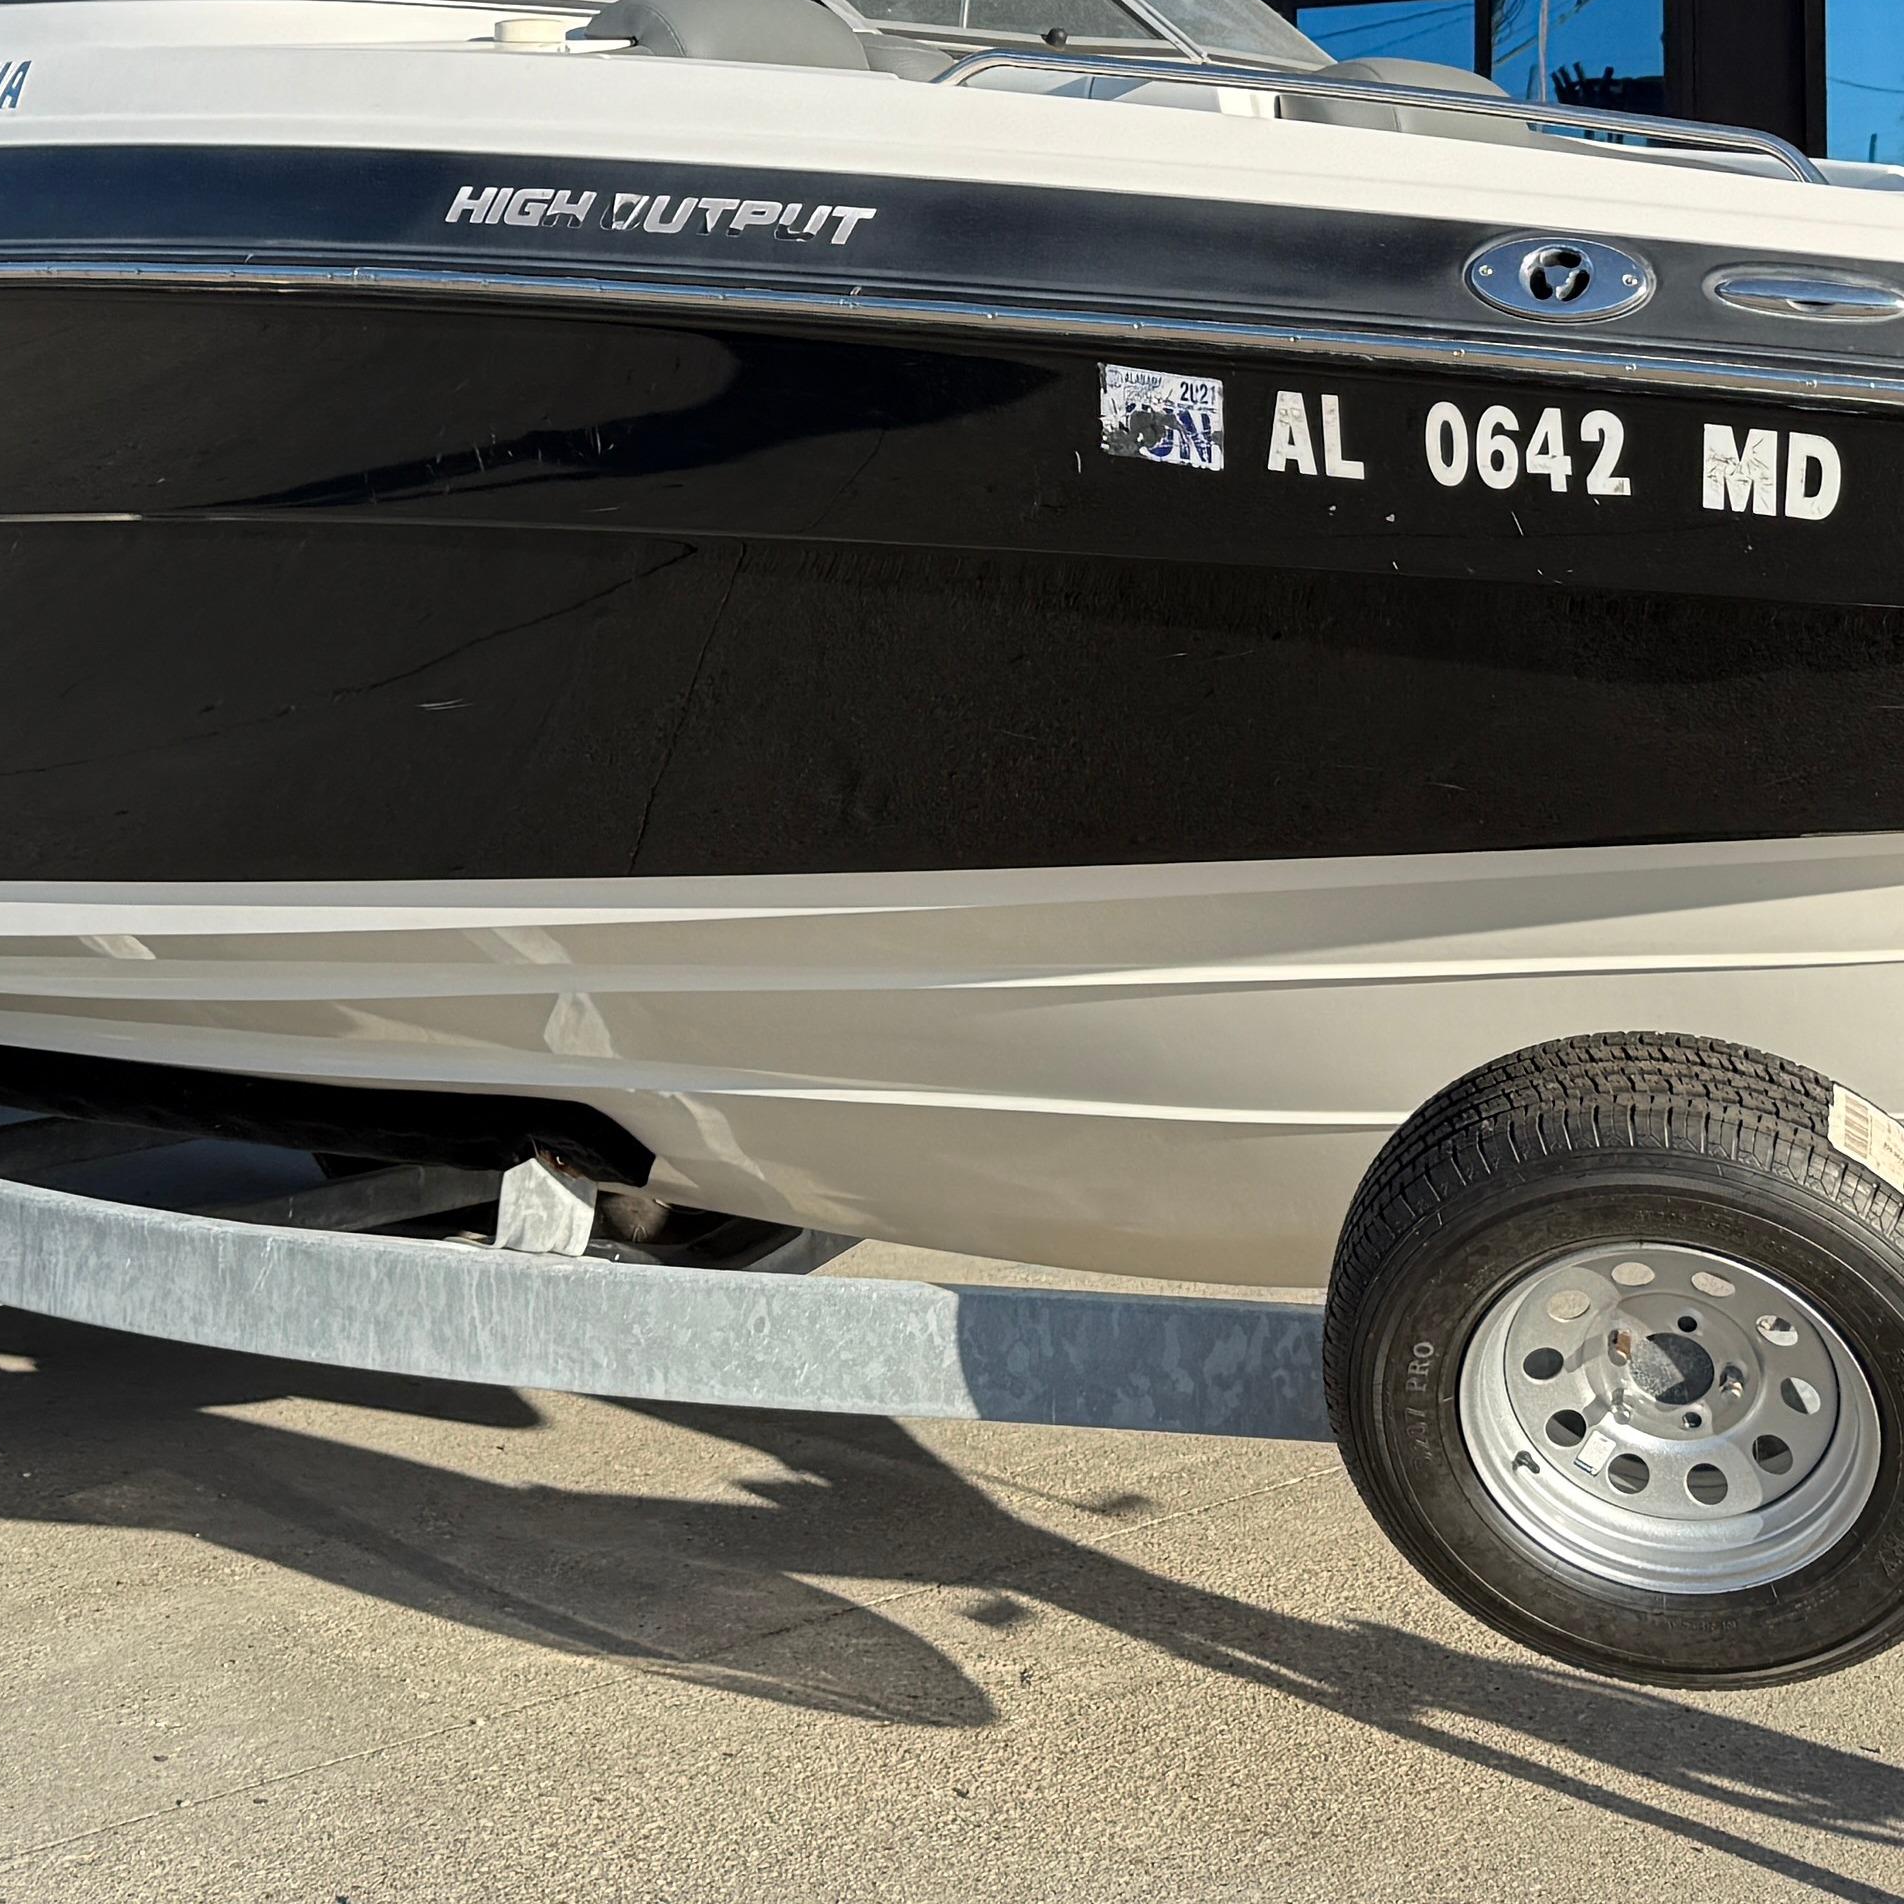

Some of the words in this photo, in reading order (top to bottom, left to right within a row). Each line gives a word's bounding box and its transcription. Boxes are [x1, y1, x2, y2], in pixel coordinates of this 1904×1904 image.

[446, 186, 596, 228] HIGH
[601, 193, 877, 245] OUTPUT
[1267, 390, 1365, 481] AL
[1424, 401, 1632, 496] 0642
[1702, 422, 1842, 522] MD
[1405, 1342, 1435, 1393] PRO
